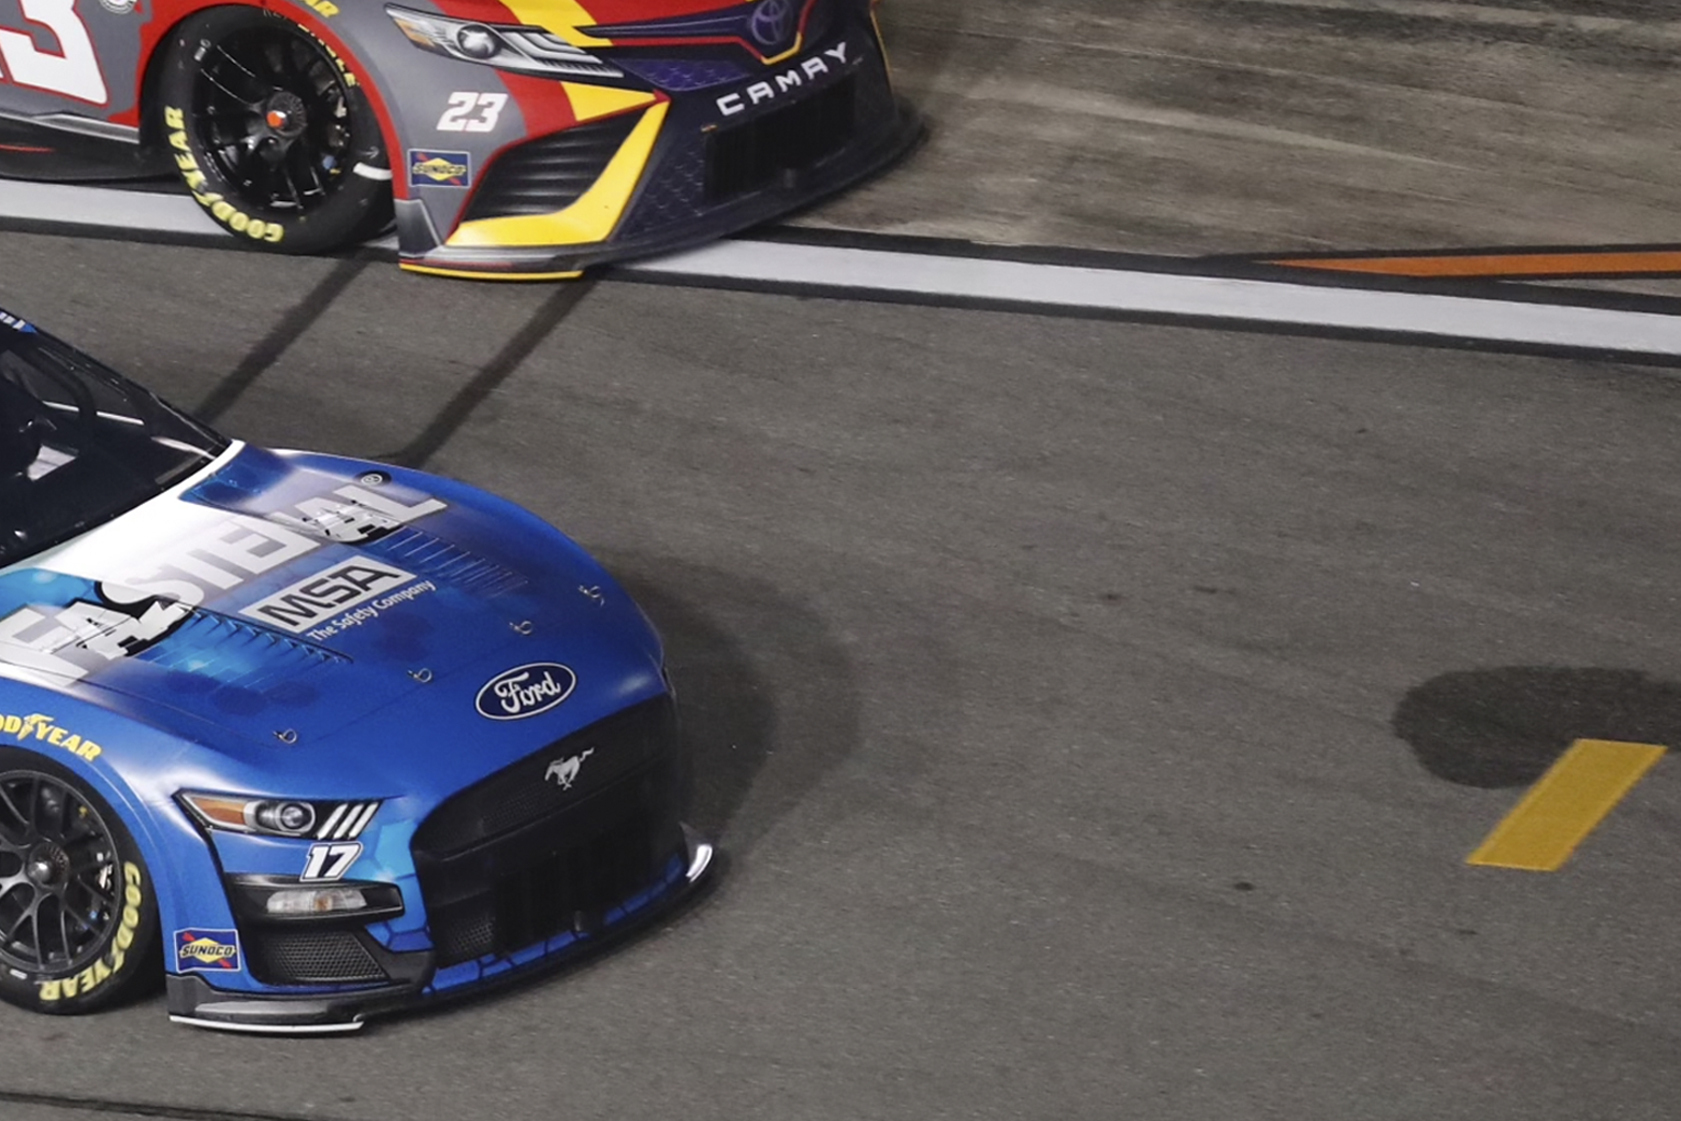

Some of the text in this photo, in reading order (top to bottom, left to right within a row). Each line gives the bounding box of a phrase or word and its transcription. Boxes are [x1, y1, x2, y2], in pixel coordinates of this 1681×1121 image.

[715, 41, 847, 116] CAMRY
[435, 91, 508, 133] 23
[163, 105, 285, 244] GOODYEAR
[258, 564, 402, 628] MSA
[306, 577, 438, 643] The Safety Company
[496, 669, 563, 714] Ford
[298, 841, 363, 883] 17
[38, 861, 143, 1002] GOODYEAR
[178, 943, 238, 961] SUNOCO
